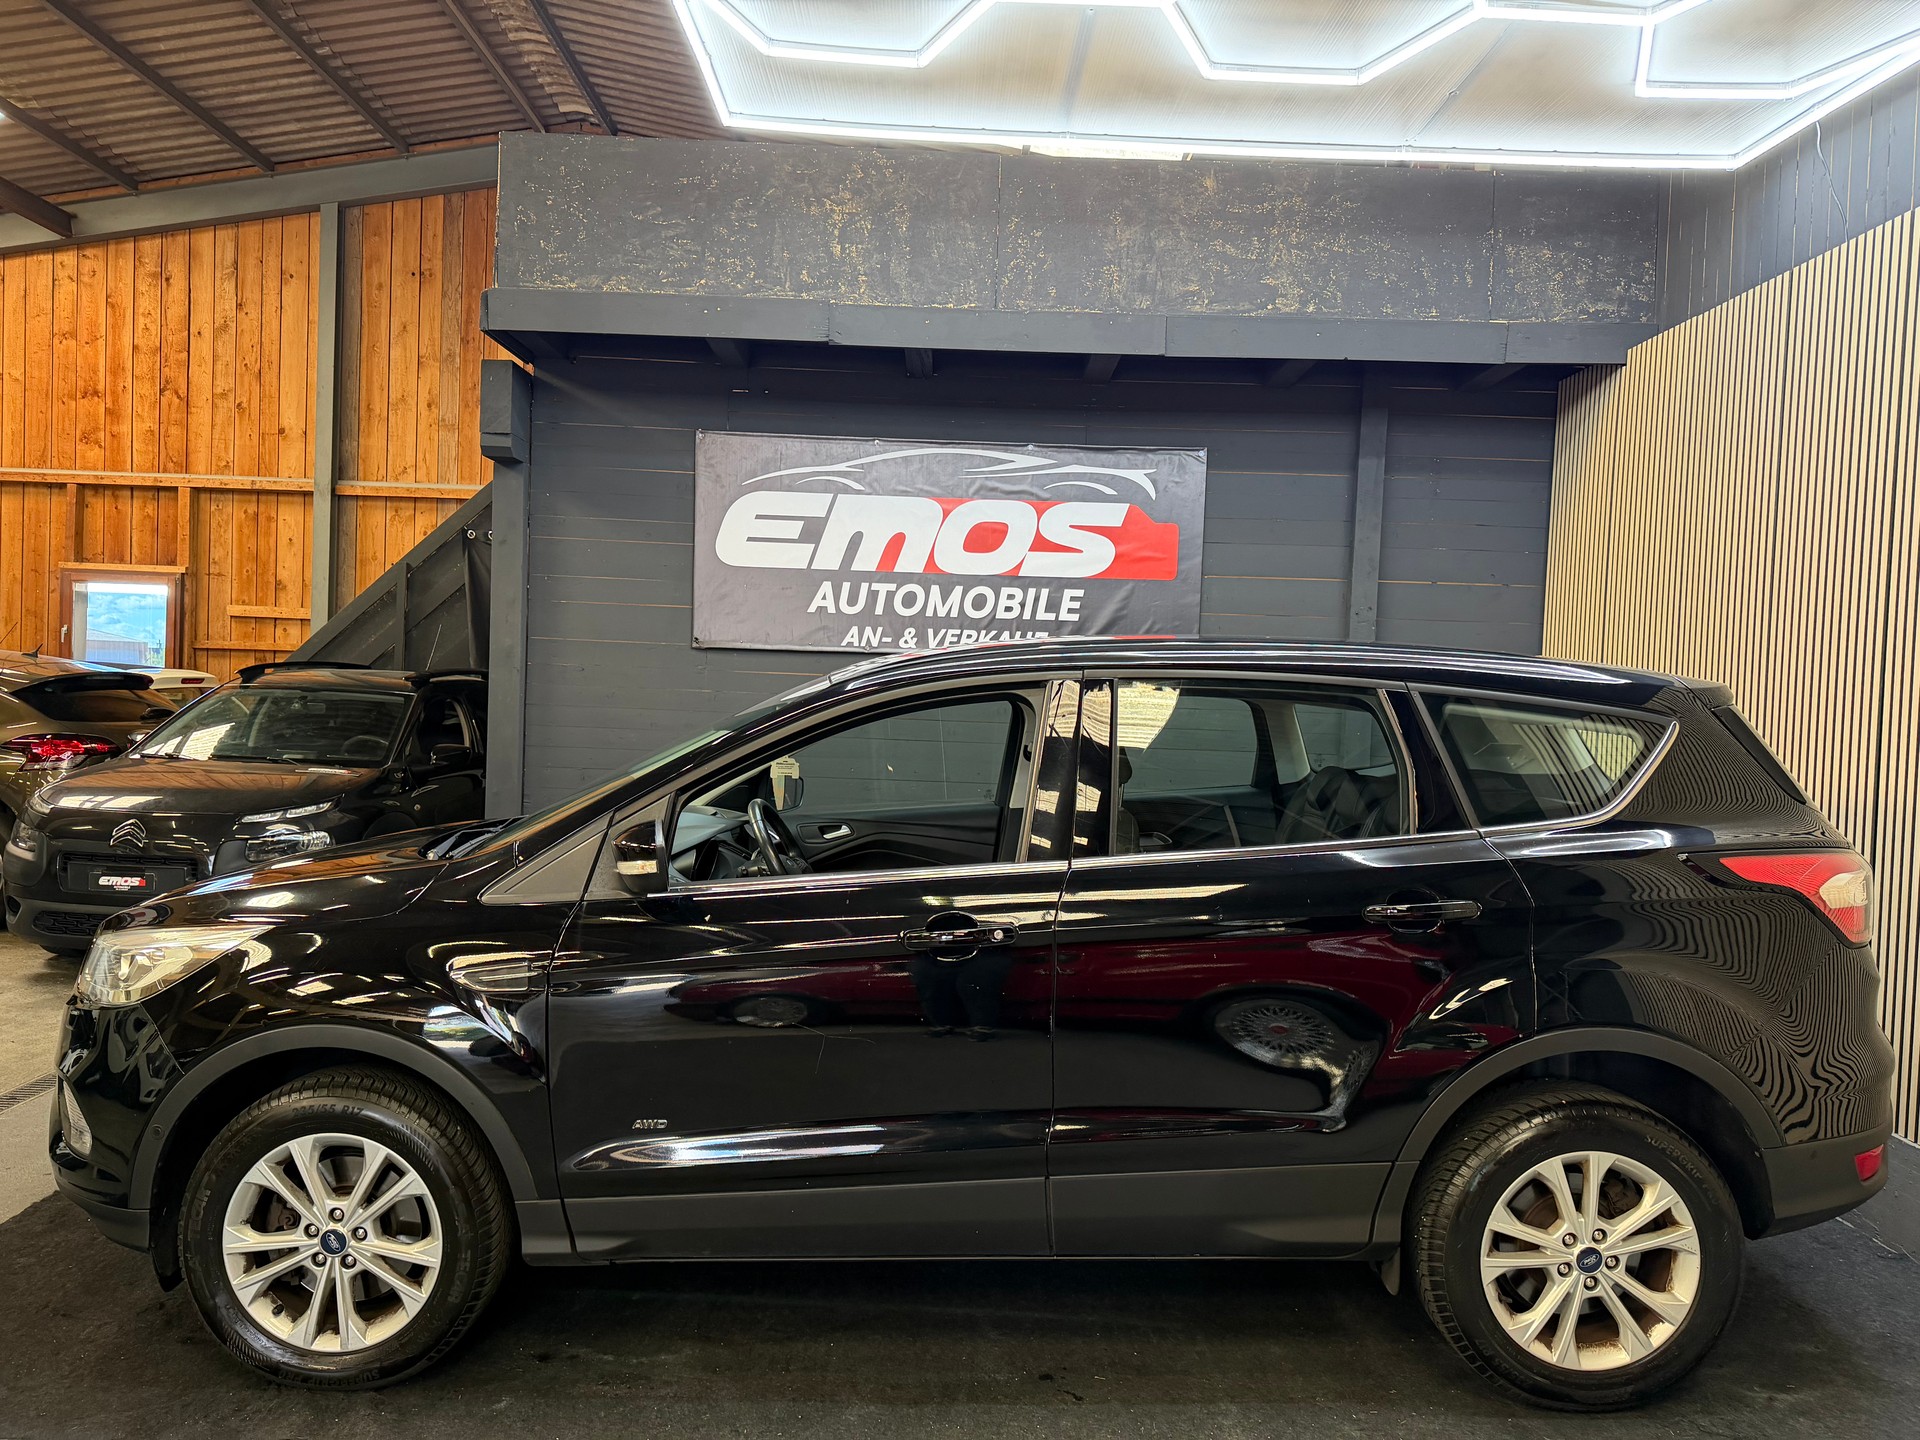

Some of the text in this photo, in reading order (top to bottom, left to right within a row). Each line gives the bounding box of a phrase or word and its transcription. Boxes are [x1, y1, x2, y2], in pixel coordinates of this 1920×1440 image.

[715, 490, 1131, 578] EMOS
[807, 580, 1086, 622] AUTOMOBILE
[841, 625, 893, 648] AN-
[898, 627, 919, 649] &
[98, 876, 142, 886] EMOS
[341, 1104, 364, 1117] R17
[632, 1119, 668, 1129] AWD
